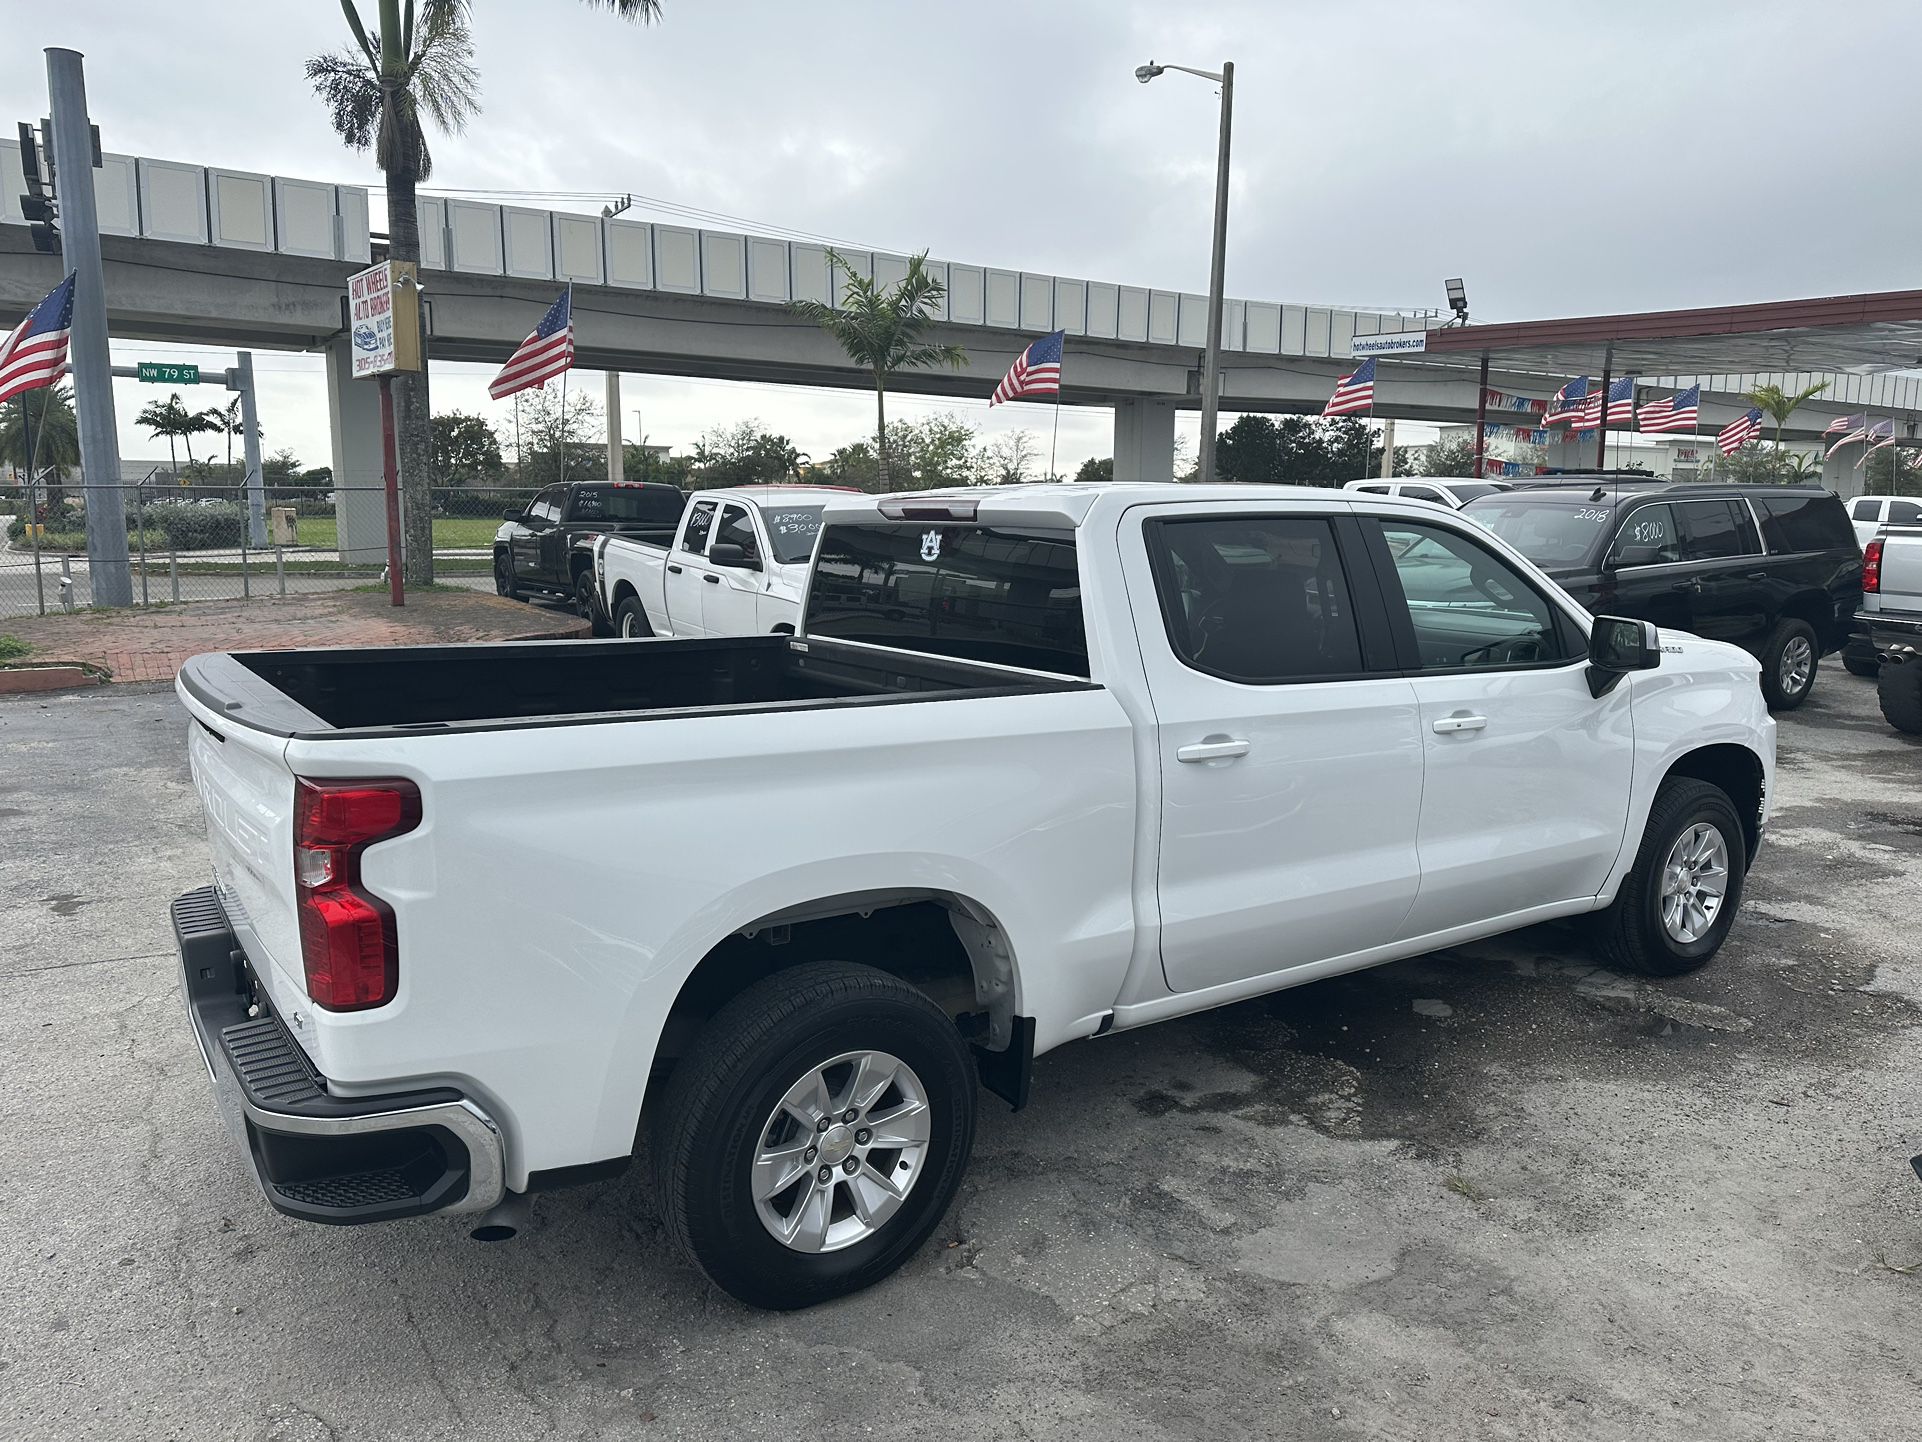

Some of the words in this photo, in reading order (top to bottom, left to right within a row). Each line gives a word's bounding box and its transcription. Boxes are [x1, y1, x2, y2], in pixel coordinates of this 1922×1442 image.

[352, 277, 364, 300] HOT
[365, 269, 388, 295] WHEELS
[1353, 338, 1424, 351] hotwheelsautobrokers.com
[142, 367, 158, 377] NW
[162, 368, 178, 379] 79
[183, 370, 195, 379] ST
[1574, 508, 1610, 523] 2018
